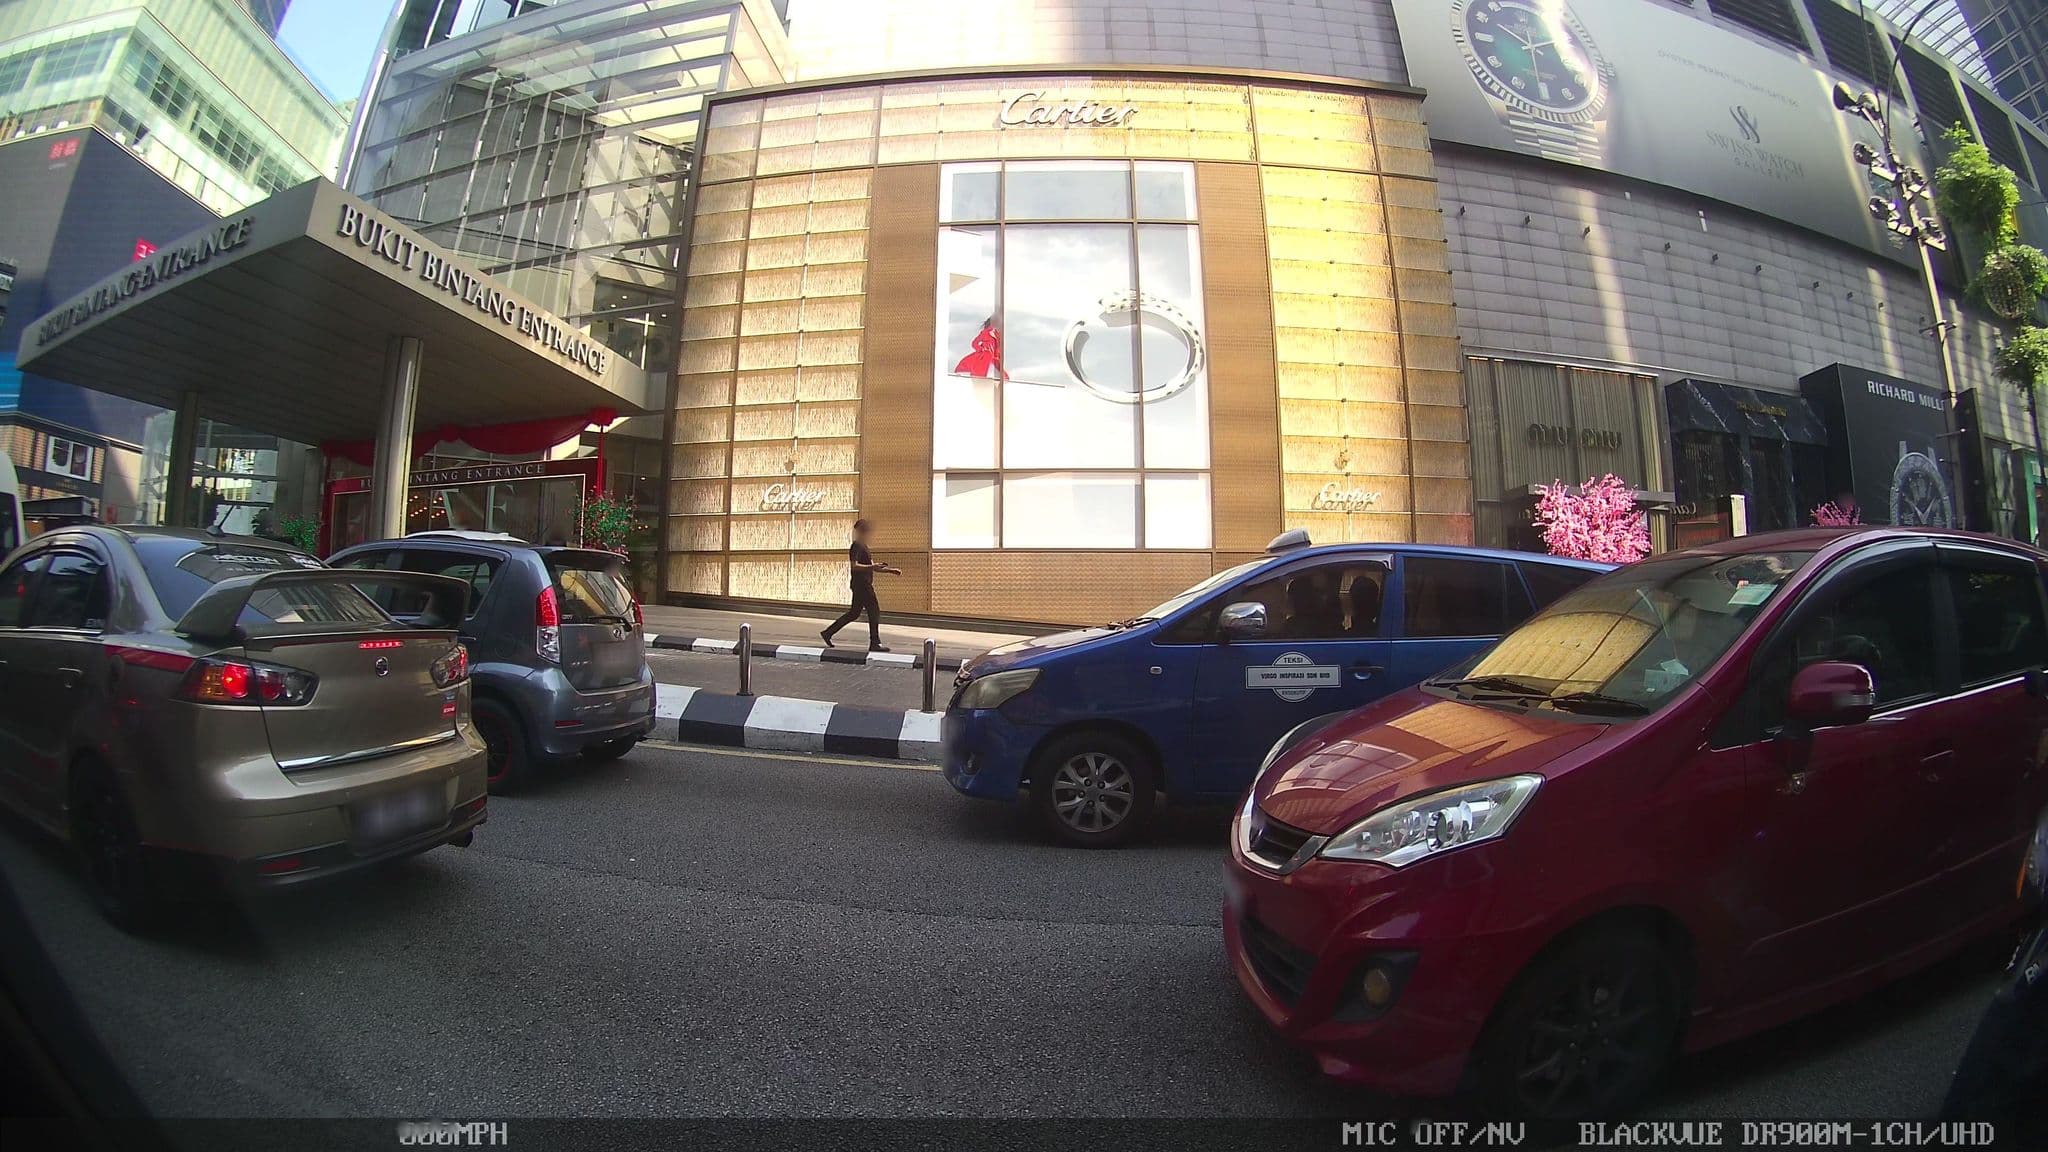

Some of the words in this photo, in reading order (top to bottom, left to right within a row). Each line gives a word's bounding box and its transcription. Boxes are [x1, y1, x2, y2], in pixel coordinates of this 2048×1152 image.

[999, 91, 1138, 125] Cartier
[1704, 130, 1752, 158] SWISS
[1754, 147, 1804, 177] WATCH
[138, 217, 252, 290] ENTRANCE
[337, 203, 420, 270] BUKIT
[421, 251, 515, 325] BINTANG
[519, 307, 607, 375] ENTRANCE
[1867, 380, 1915, 403] RICHARD
[410, 469, 458, 485] INTANG
[467, 464, 544, 480] ENTRANCE
[763, 483, 826, 504] Cartier
[1318, 482, 1381, 503] Cartier
